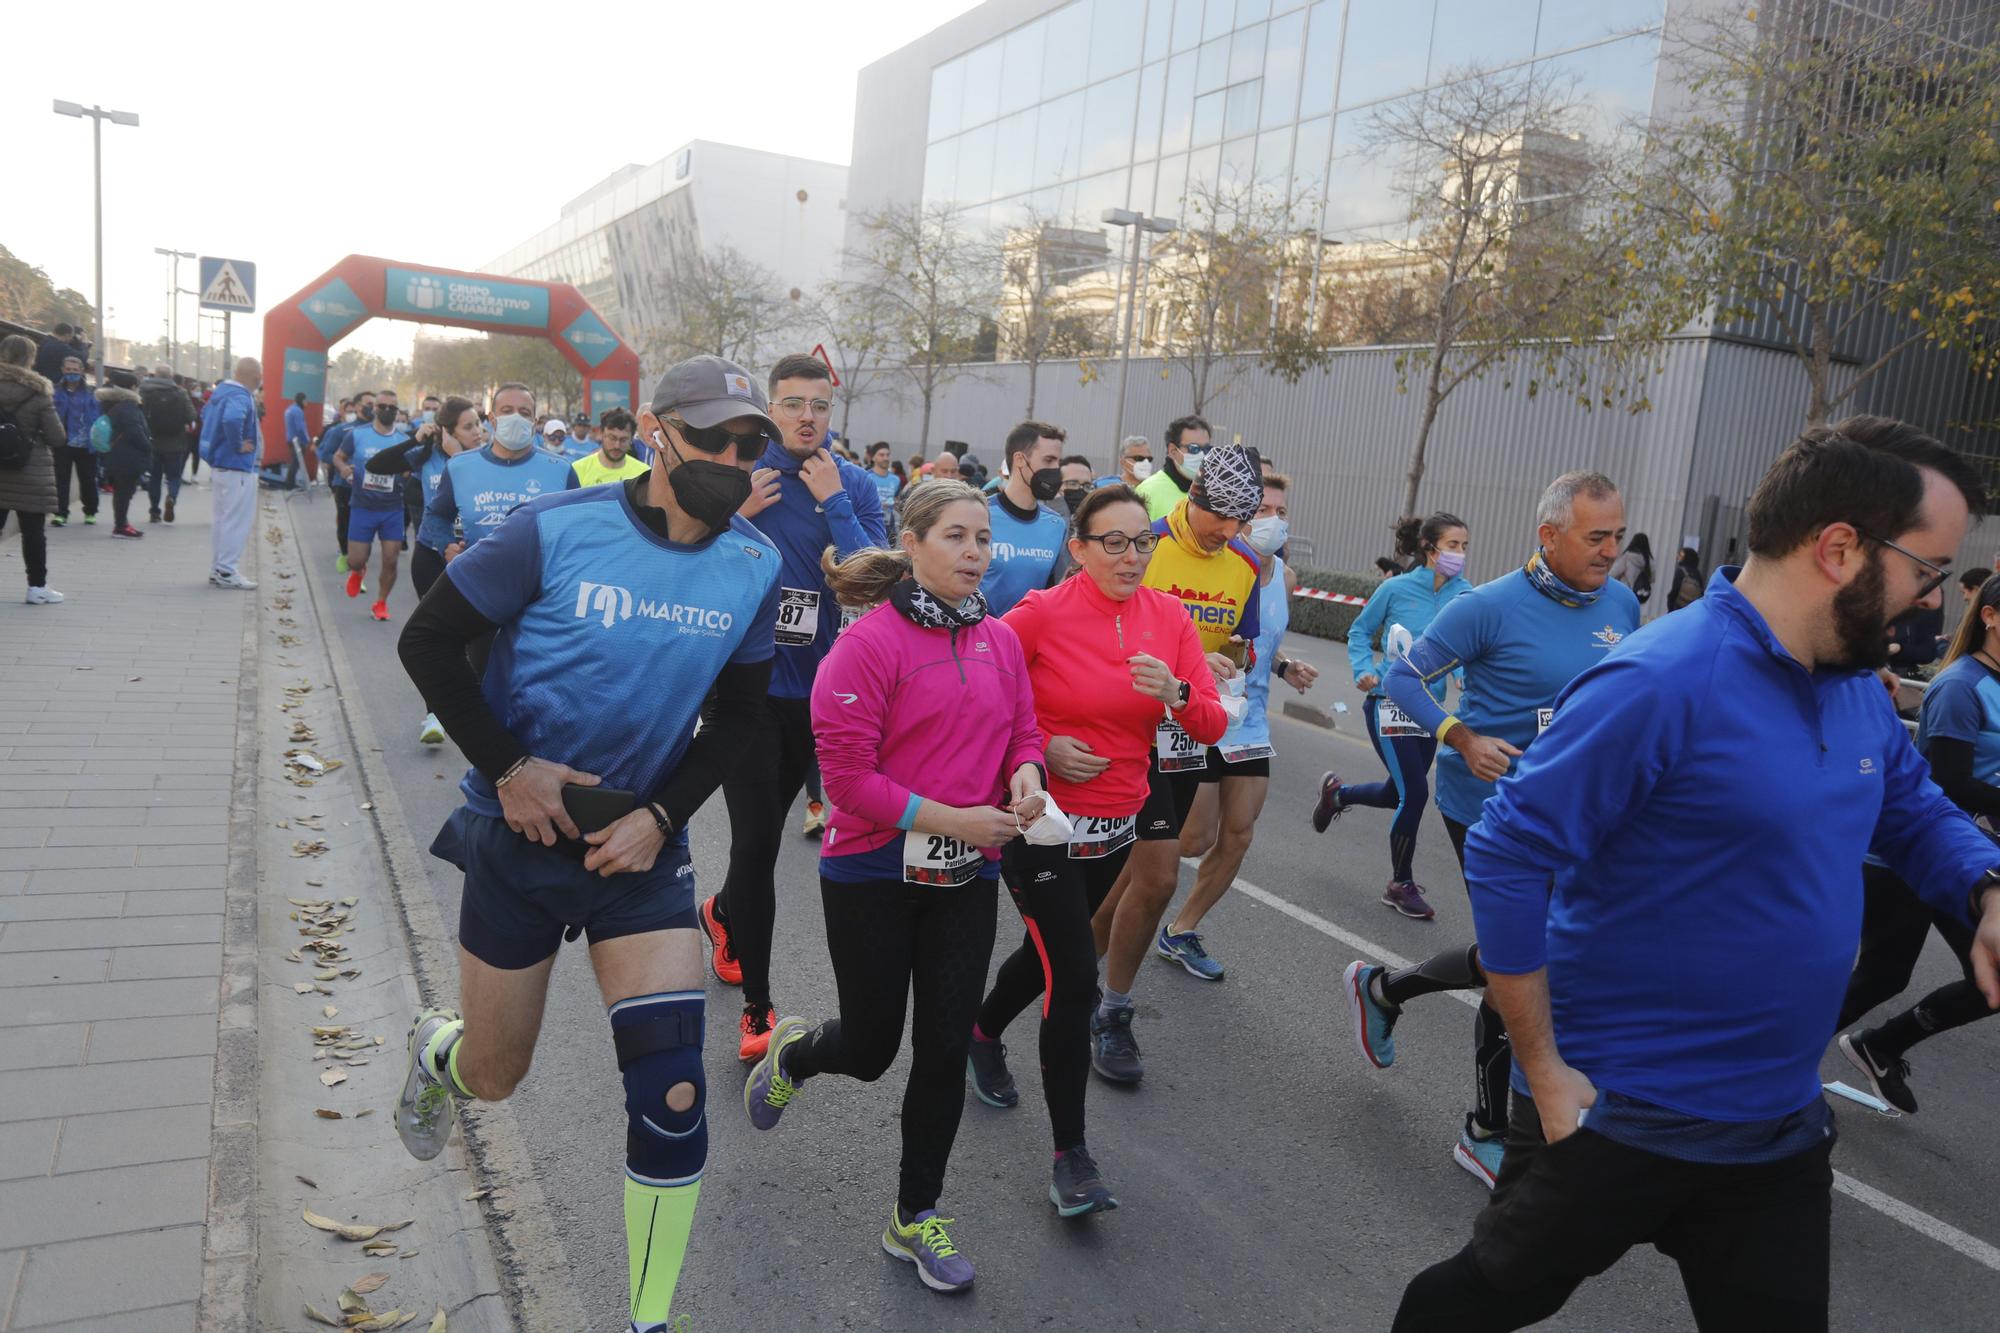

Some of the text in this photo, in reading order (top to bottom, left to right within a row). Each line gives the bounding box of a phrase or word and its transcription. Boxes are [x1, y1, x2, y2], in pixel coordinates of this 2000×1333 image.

[448, 283, 490, 297] GRUPO
[449, 292, 531, 311] COOPERATIVO
[448, 302, 504, 317] CAJAMAR
[474, 490, 495, 506] 10K
[495, 492, 517, 503] PAS
[1016, 547, 1055, 559] MARTICO
[636, 597, 734, 632] MARTICO
[776, 604, 805, 626] 87
[944, 856, 967, 869] Patricia
